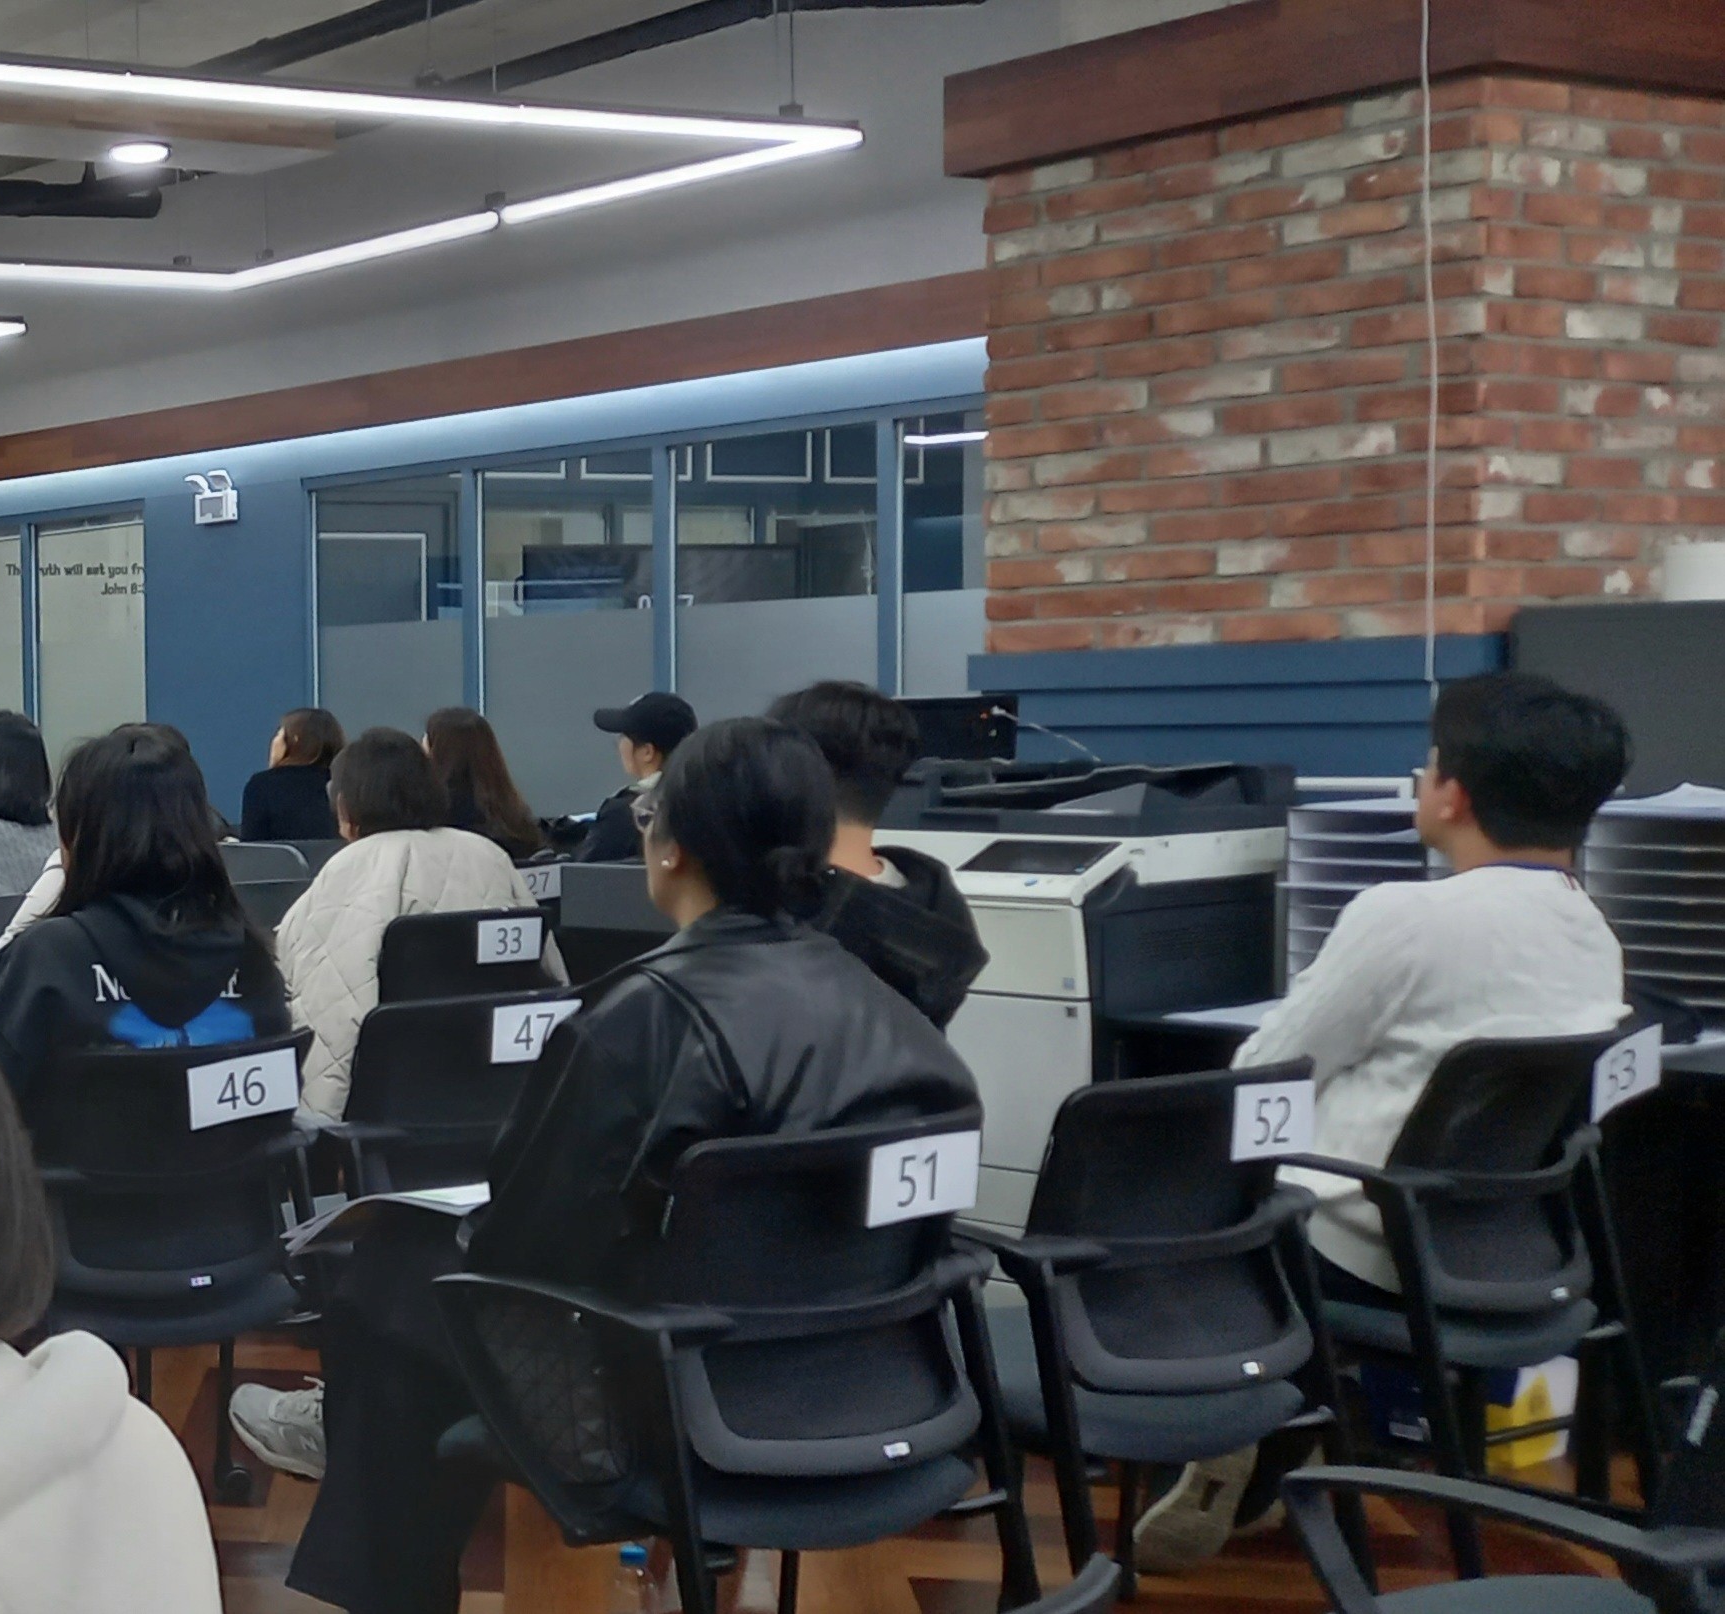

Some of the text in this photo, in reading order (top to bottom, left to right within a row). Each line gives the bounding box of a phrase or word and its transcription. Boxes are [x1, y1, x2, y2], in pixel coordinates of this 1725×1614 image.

[64, 563, 83, 575] will
[108, 566, 128, 578] you
[101, 582, 128, 595] John
[528, 871, 550, 895] 27
[496, 926, 522, 955] 33
[514, 1013, 556, 1051] 47
[217, 1066, 266, 1110] 46
[1608, 1048, 1636, 1100] 53
[1253, 1095, 1292, 1146] 52
[897, 1151, 939, 1208] 51
